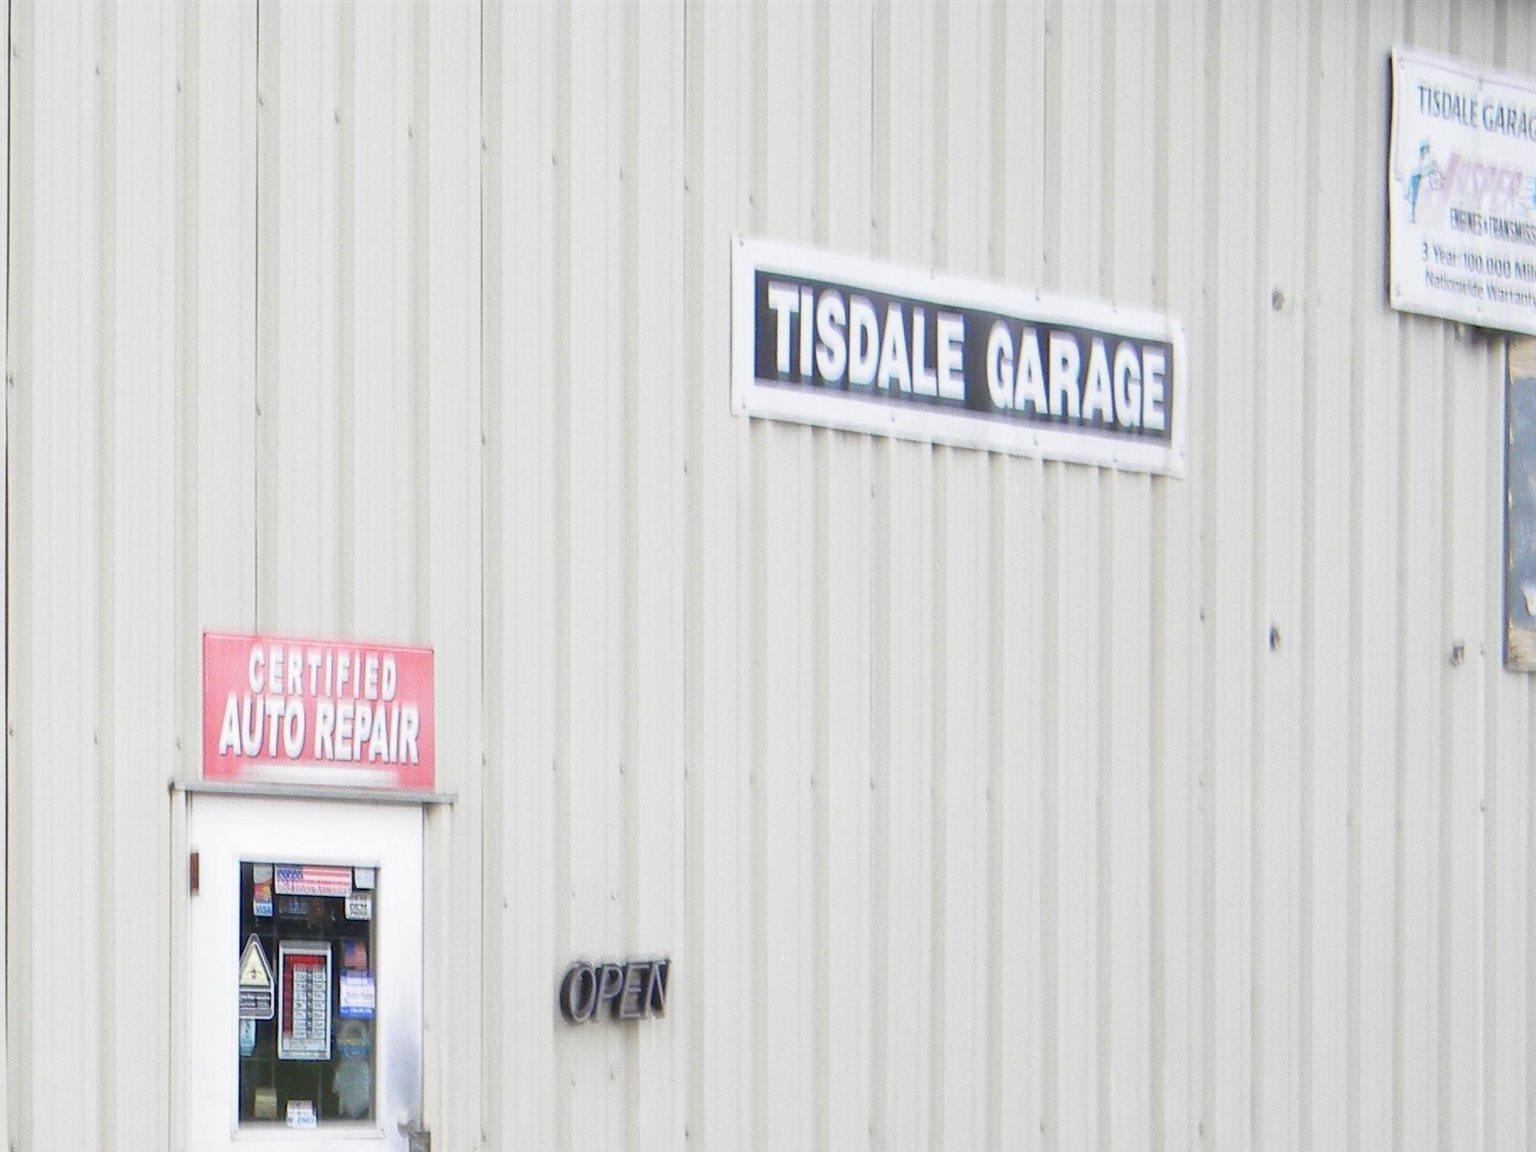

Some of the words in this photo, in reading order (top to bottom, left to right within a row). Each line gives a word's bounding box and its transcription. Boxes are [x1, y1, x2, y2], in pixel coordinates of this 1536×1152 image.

[1417, 85, 1477, 129] TISDALE
[1422, 242, 1429, 262] 3
[1514, 261, 1536, 283] Mil
[767, 281, 964, 400] TISDALE
[986, 320, 1166, 431] GARAGE
[248, 646, 397, 702] CERTIFIED
[219, 691, 306, 760] AUTO
[315, 697, 420, 765] REPAIR
[559, 958, 670, 1023] OPEN
